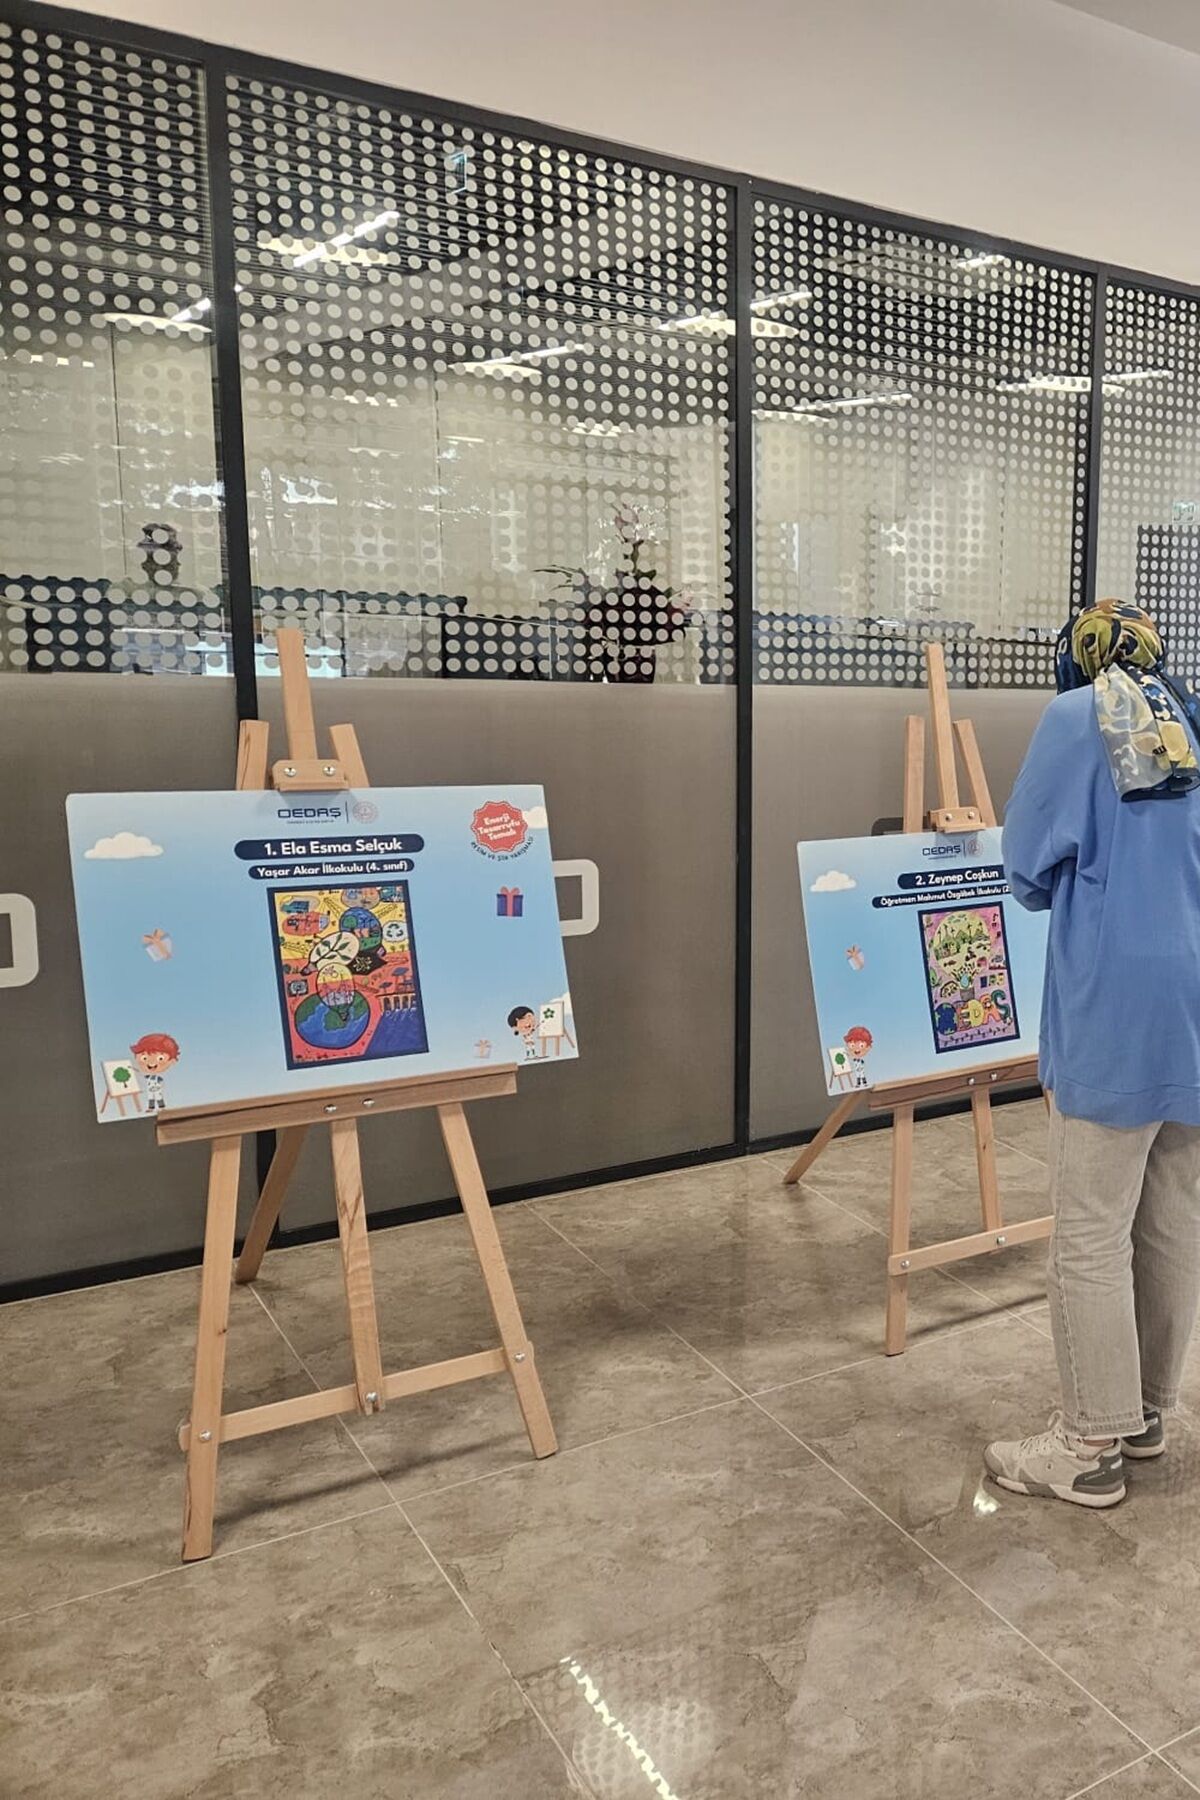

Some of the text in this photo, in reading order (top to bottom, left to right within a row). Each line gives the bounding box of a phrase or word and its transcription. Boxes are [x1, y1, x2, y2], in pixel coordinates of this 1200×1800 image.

[264, 837, 403, 856] 1. Ela Esma Selçuk
[257, 860, 408, 878] Yaşar Akar İlkokulu (4. sınıf)
[915, 868, 999, 887] 2. Zeynep Coşkun
[880, 896, 917, 907] Öğretmen
[917, 892, 946, 902] Mahmut
